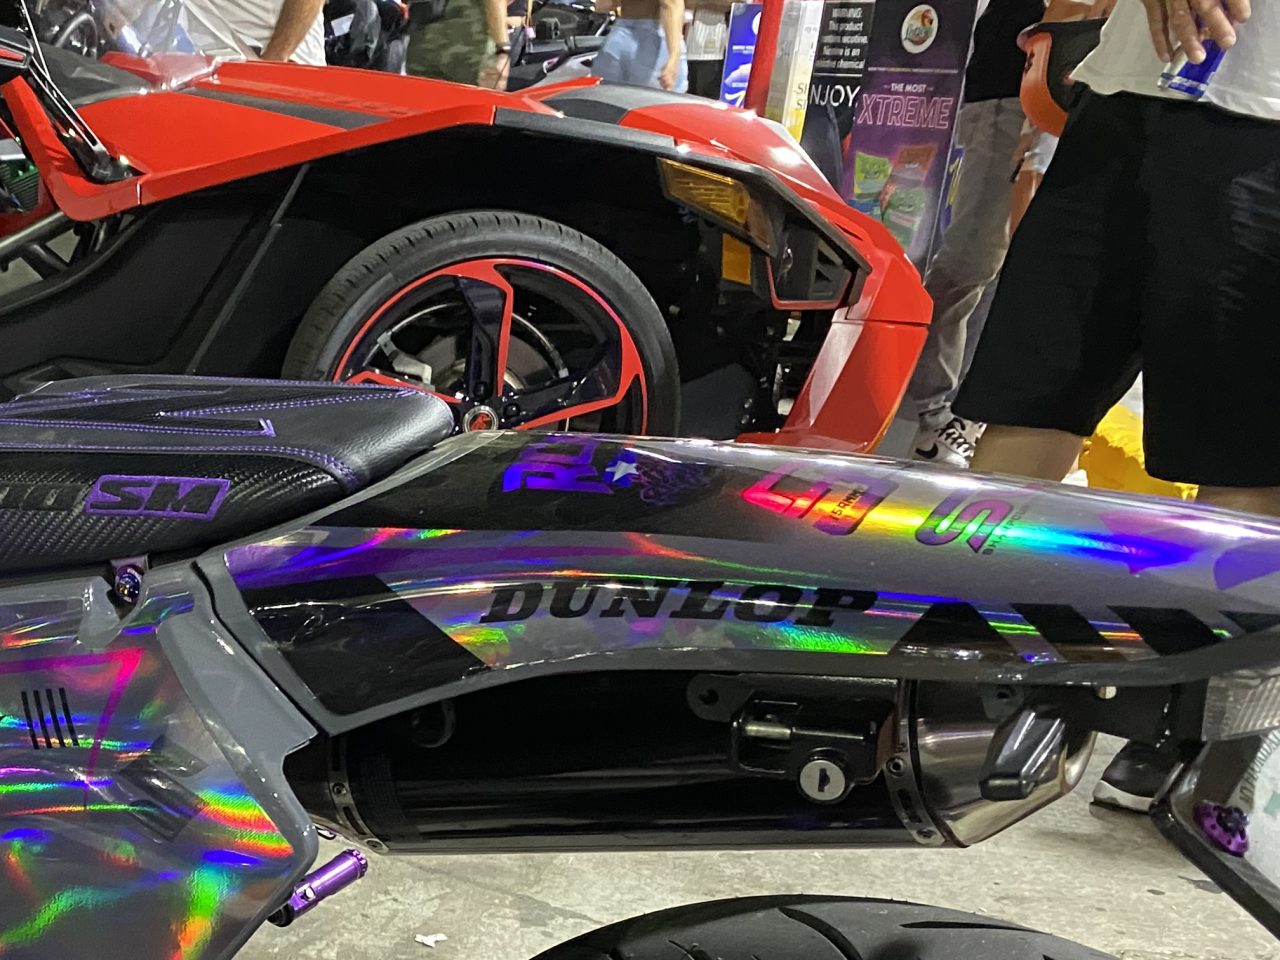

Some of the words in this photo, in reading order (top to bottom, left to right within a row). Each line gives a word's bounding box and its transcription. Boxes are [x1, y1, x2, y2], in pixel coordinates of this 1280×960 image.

[891, 83, 904, 92] THE
[904, 84, 927, 93] MOST
[857, 94, 954, 129] XTREME
[89, 480, 223, 515] SM
[479, 579, 879, 628] DUNLOP
